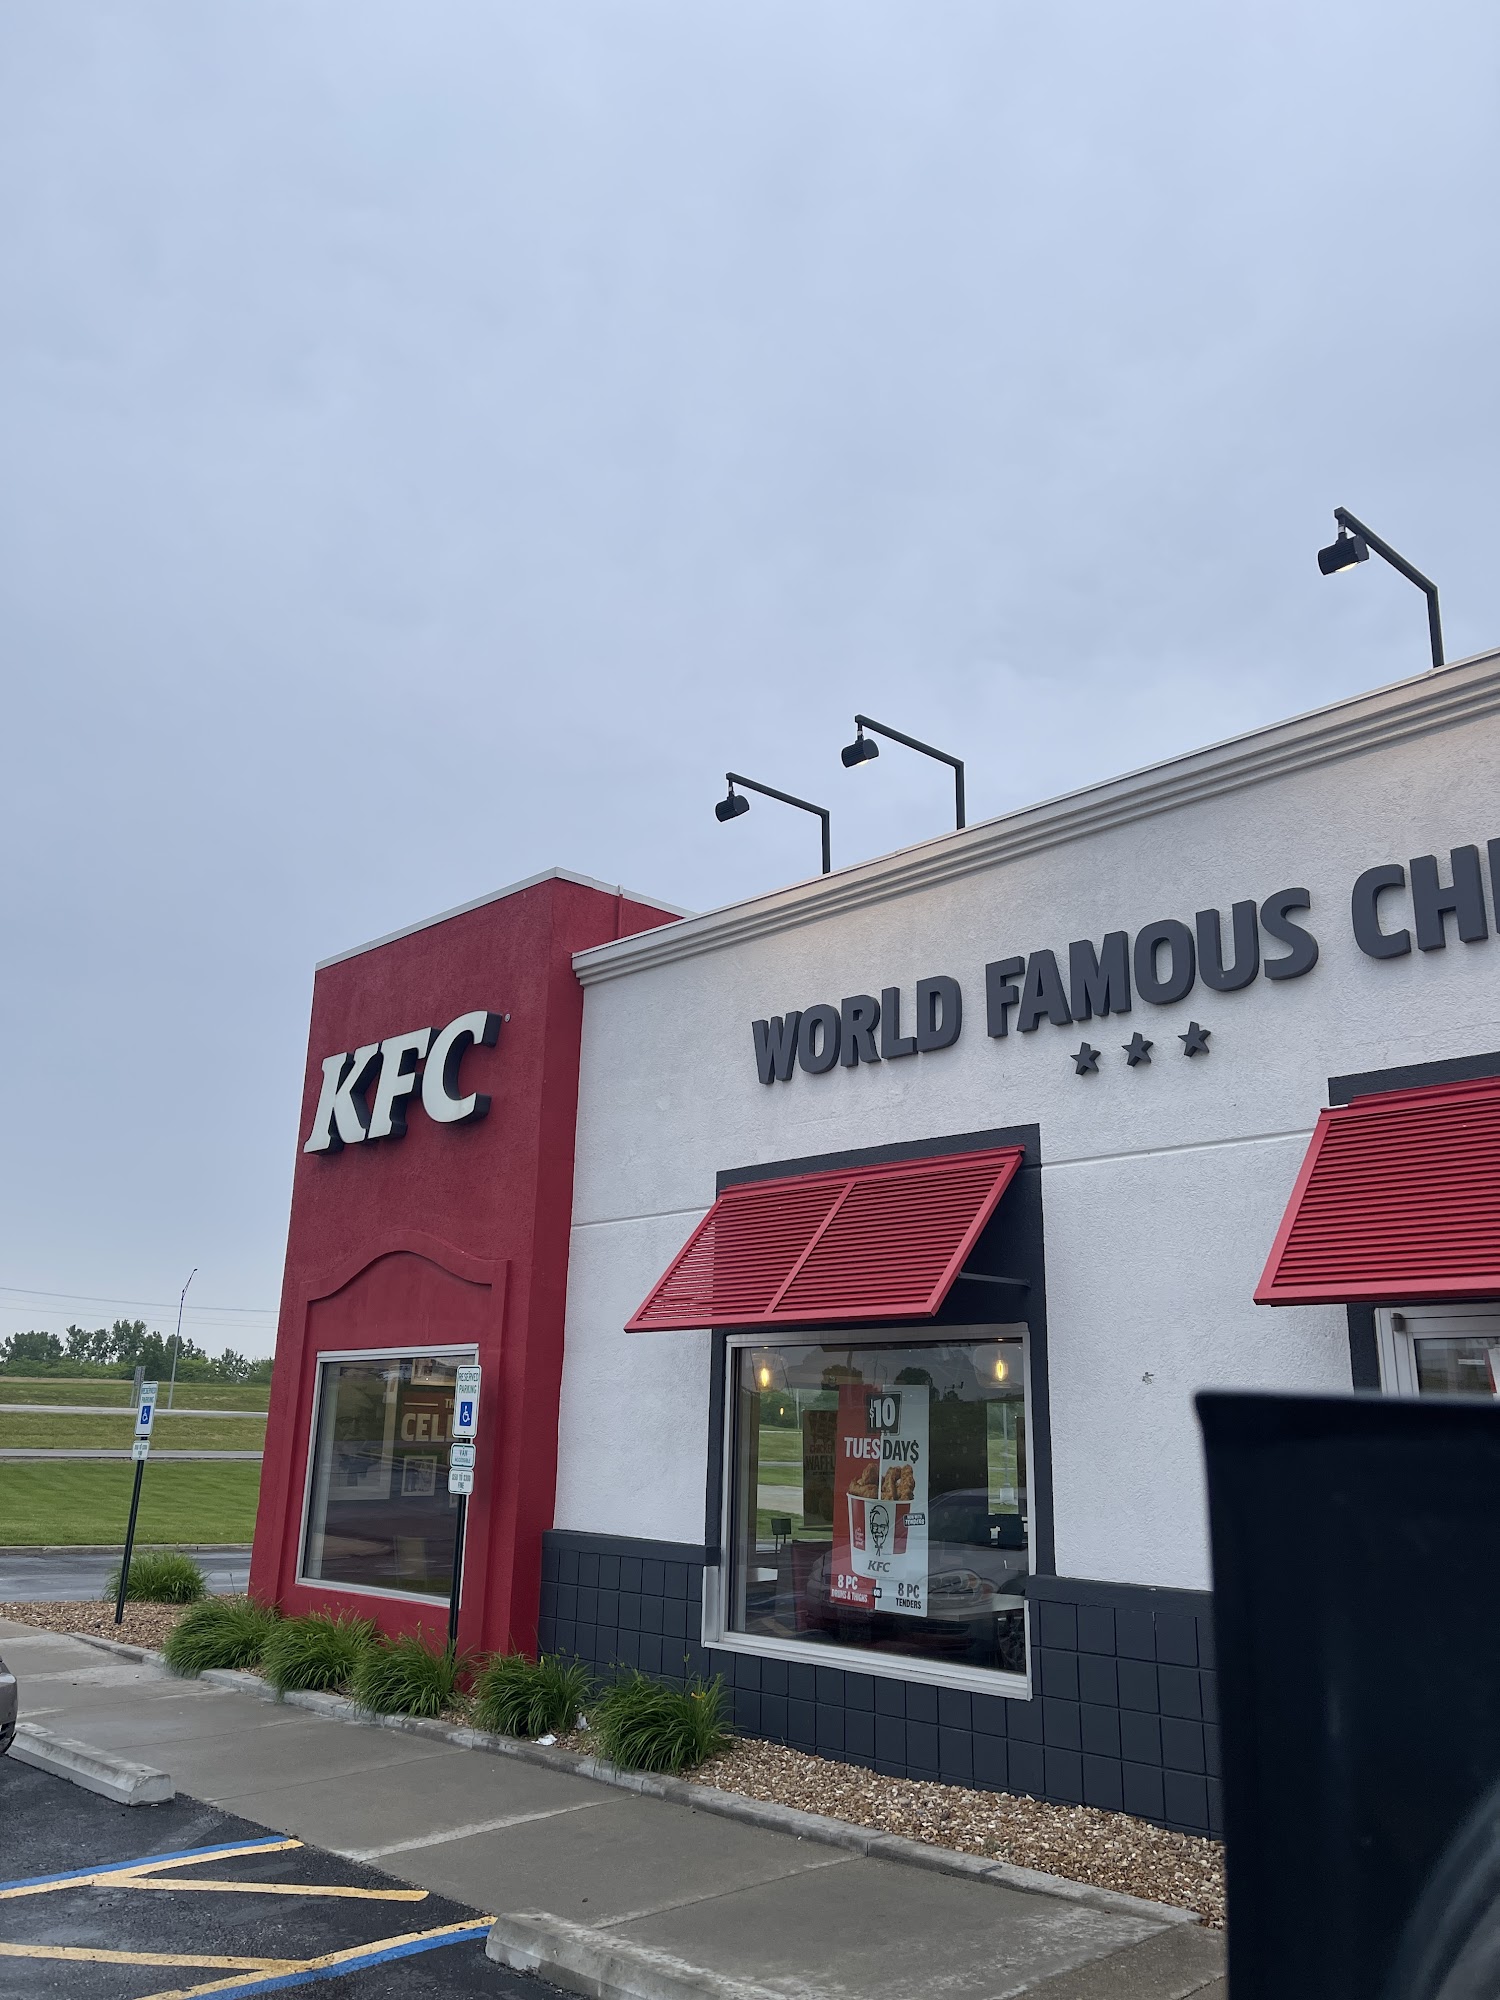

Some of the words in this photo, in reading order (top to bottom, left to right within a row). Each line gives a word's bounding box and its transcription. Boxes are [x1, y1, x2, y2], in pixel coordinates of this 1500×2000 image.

[751, 975, 962, 1085] WORLD
[985, 887, 1319, 1038] FAMOUS
[304, 1010, 501, 1154] KFC
[458, 1372, 479, 1382] RESERVED
[458, 1384, 477, 1394] PARKING
[445, 1398, 454, 1408] TH
[869, 1397, 896, 1429] $10
[867, 1560, 891, 1573] KFC
[838, 1574, 844, 1588] 8
[845, 1575, 858, 1591] PC
[873, 1589, 881, 1597] OR
[898, 1582, 904, 1596] 8
[907, 1583, 920, 1599] PC
[851, 1592, 868, 1603] THIGHS
[896, 1597, 922, 1610] TENDERS
